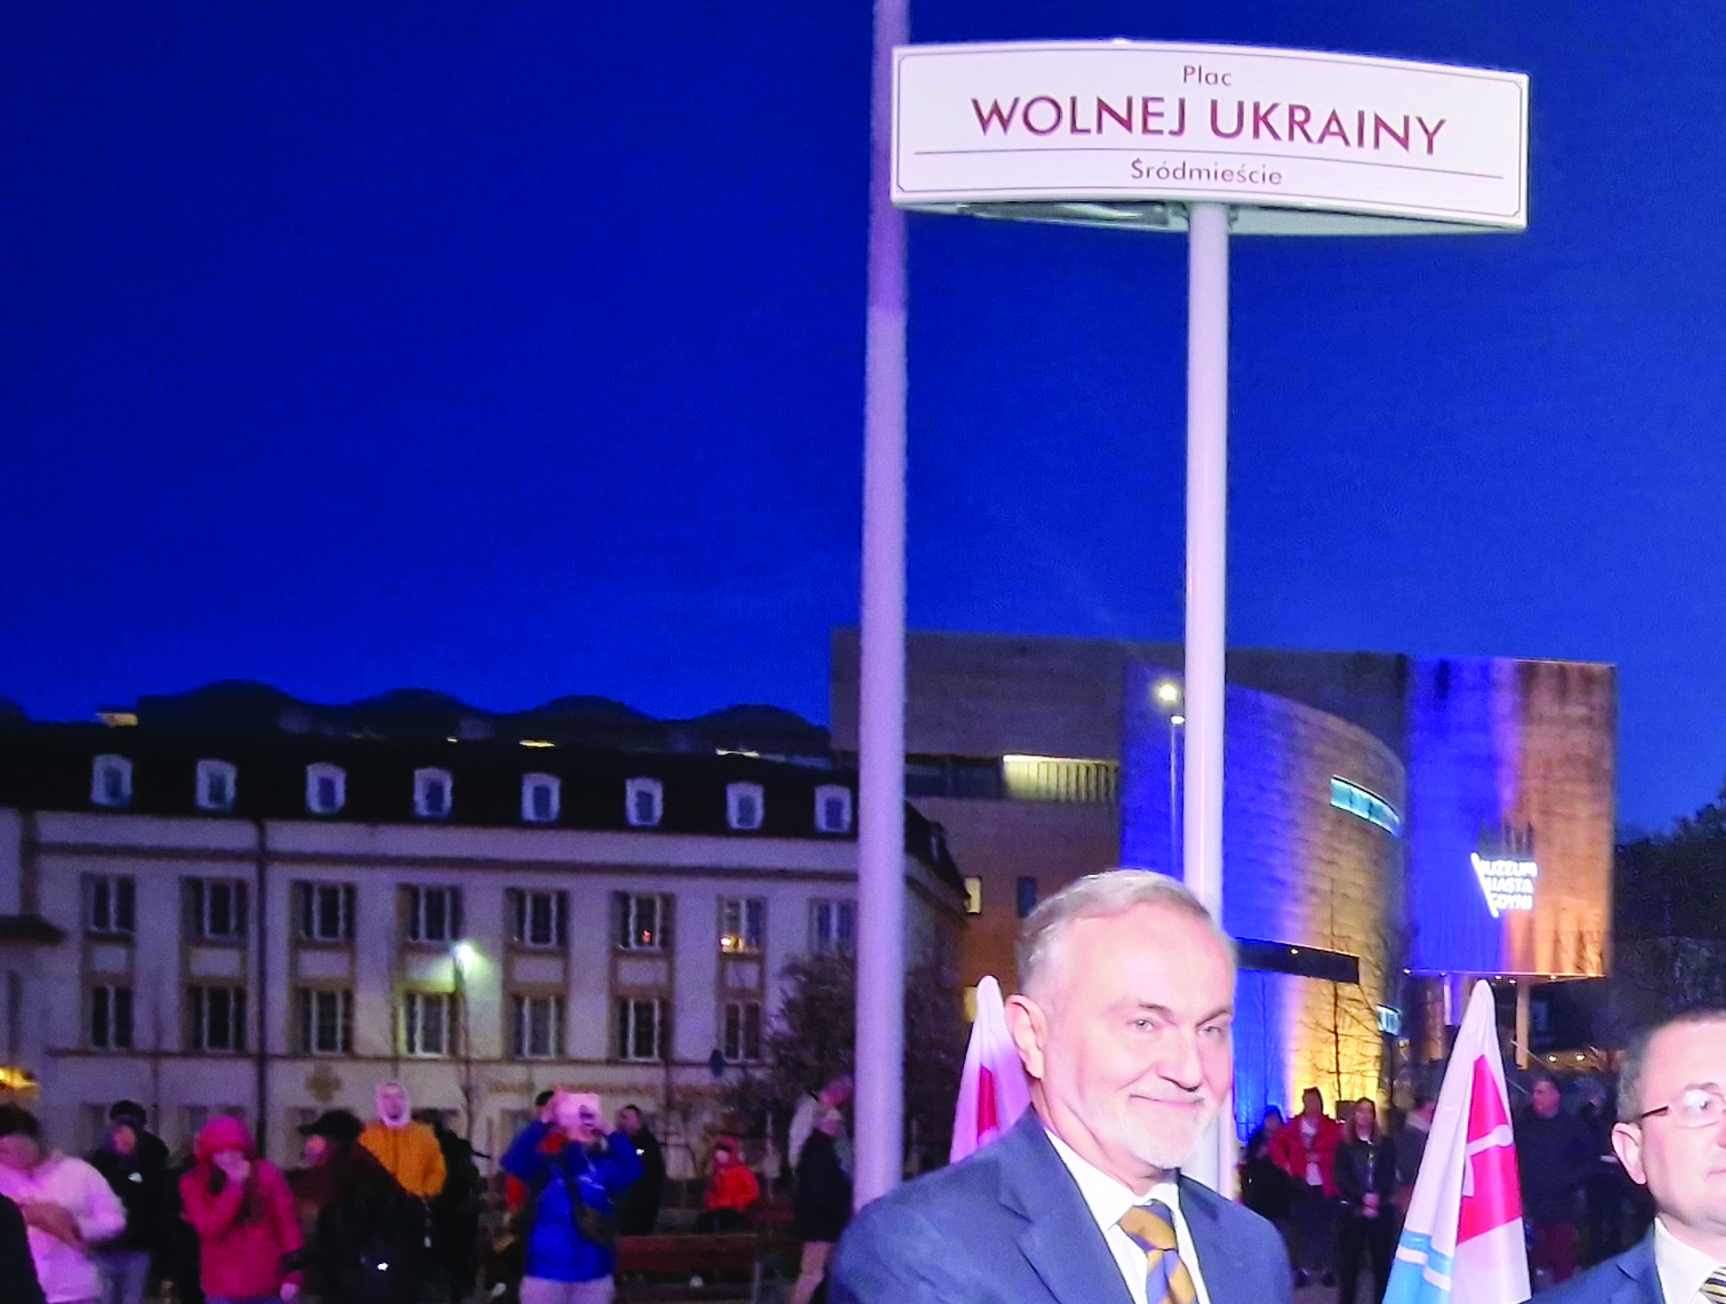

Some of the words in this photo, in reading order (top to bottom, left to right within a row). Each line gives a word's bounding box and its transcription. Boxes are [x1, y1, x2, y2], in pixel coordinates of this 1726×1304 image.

[1182, 64, 1233, 87] Plac
[970, 95, 1187, 137] WOLNEJ
[1209, 98, 1447, 155] UKRAINY
[1130, 156, 1283, 186] Śródmieście
